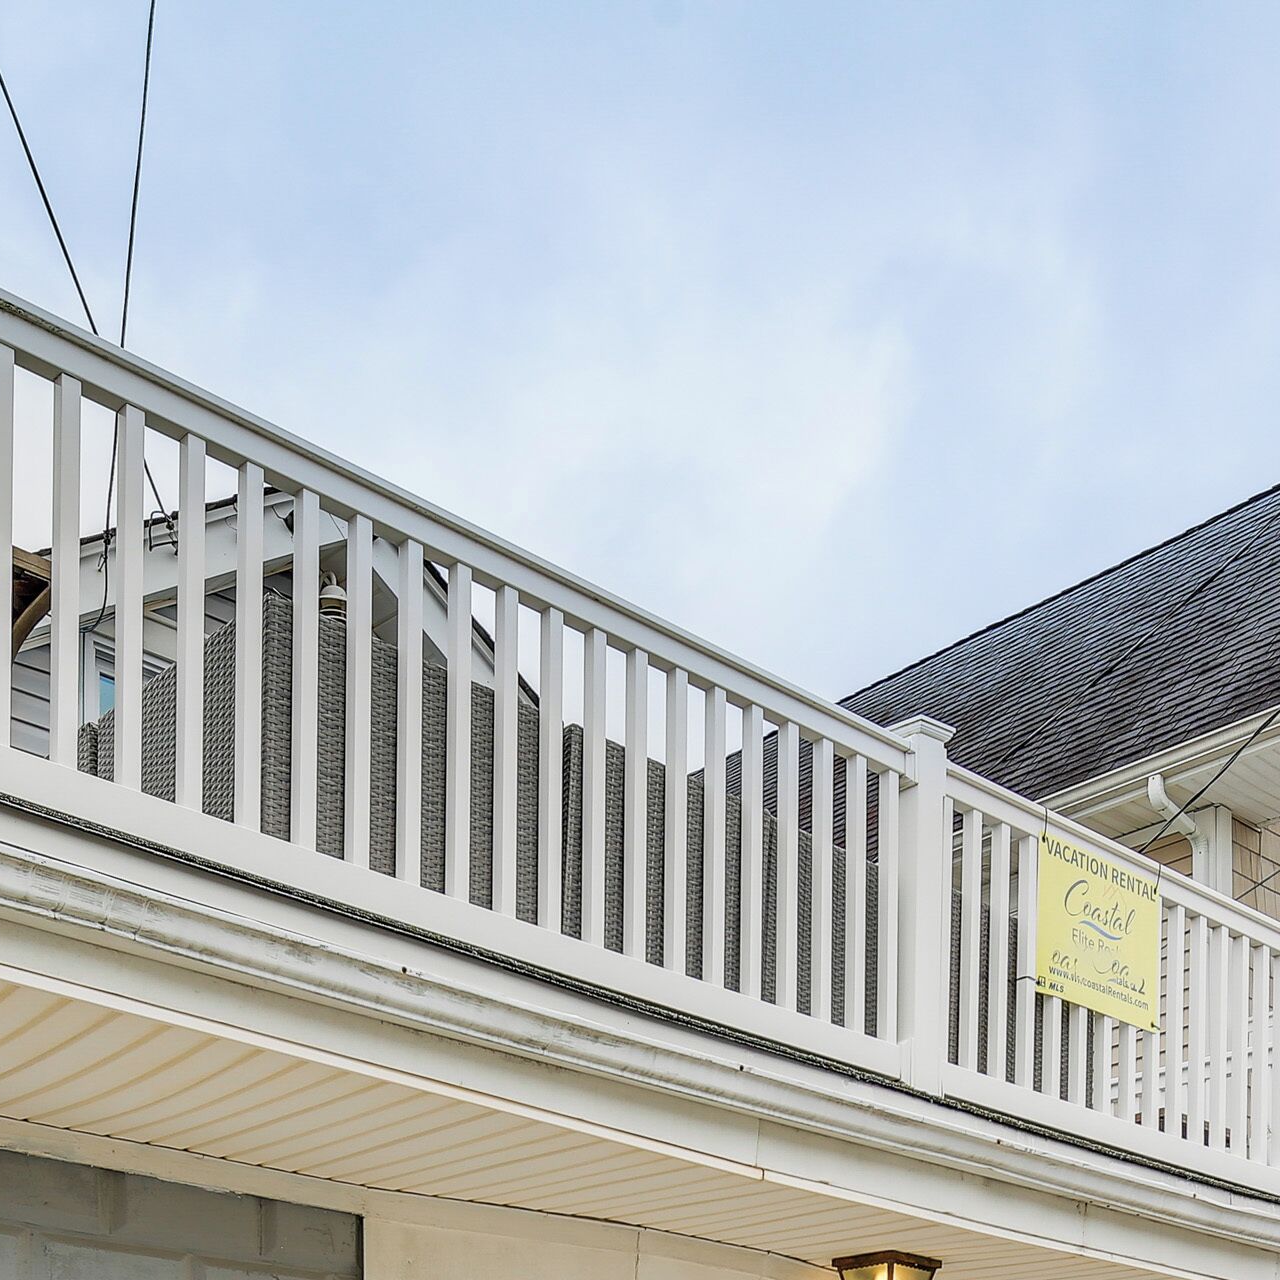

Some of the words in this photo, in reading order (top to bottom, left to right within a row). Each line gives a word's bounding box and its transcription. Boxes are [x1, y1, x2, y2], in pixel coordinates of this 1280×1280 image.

[1046, 836, 1108, 881] VACATION
[1111, 867, 1156, 903] RENTAL
[1064, 879, 1136, 935] Coastal
[1048, 981, 1065, 993] MLS
